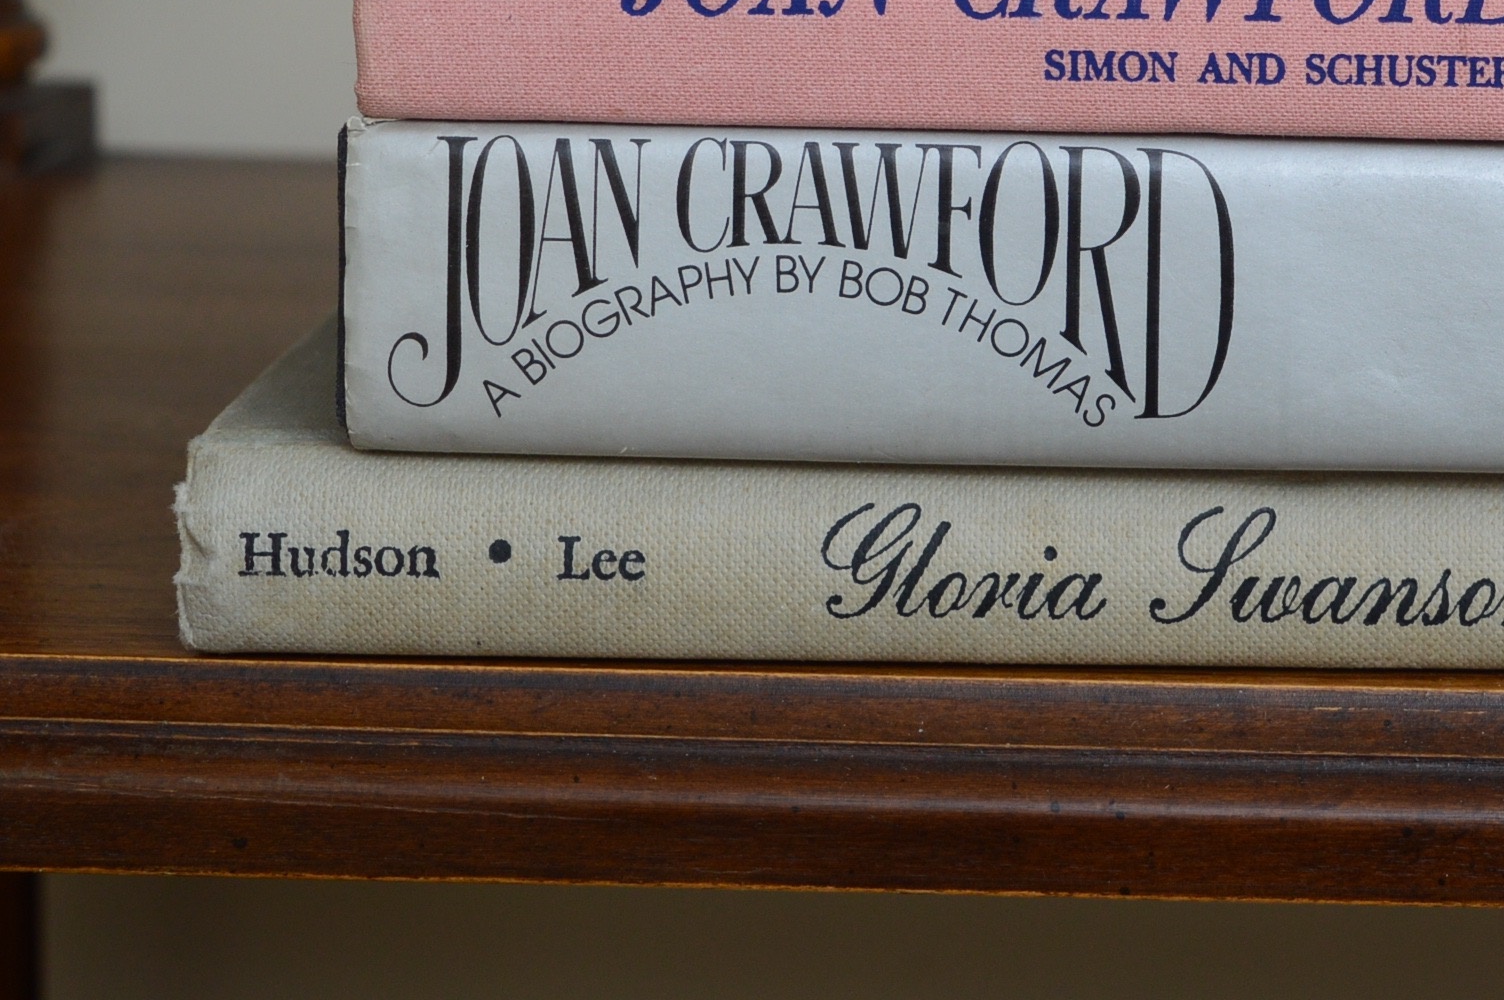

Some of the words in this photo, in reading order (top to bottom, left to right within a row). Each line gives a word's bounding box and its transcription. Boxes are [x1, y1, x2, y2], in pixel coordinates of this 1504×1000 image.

[1043, 49, 1179, 84] SIMON
[1199, 51, 1287, 86] AND
[387, 134, 652, 408] JOAN
[675, 137, 1235, 420] CRAWFORD
[482, 379, 522, 418] A
[510, 255, 760, 386] BIOGRAPHY
[775, 254, 827, 294] BY
[838, 259, 931, 315] BOB
[940, 286, 1117, 428] THOMAS
[238, 530, 441, 579] Hudson
[556, 535, 647, 581] Lee
[819, 501, 1109, 621] Gloria
